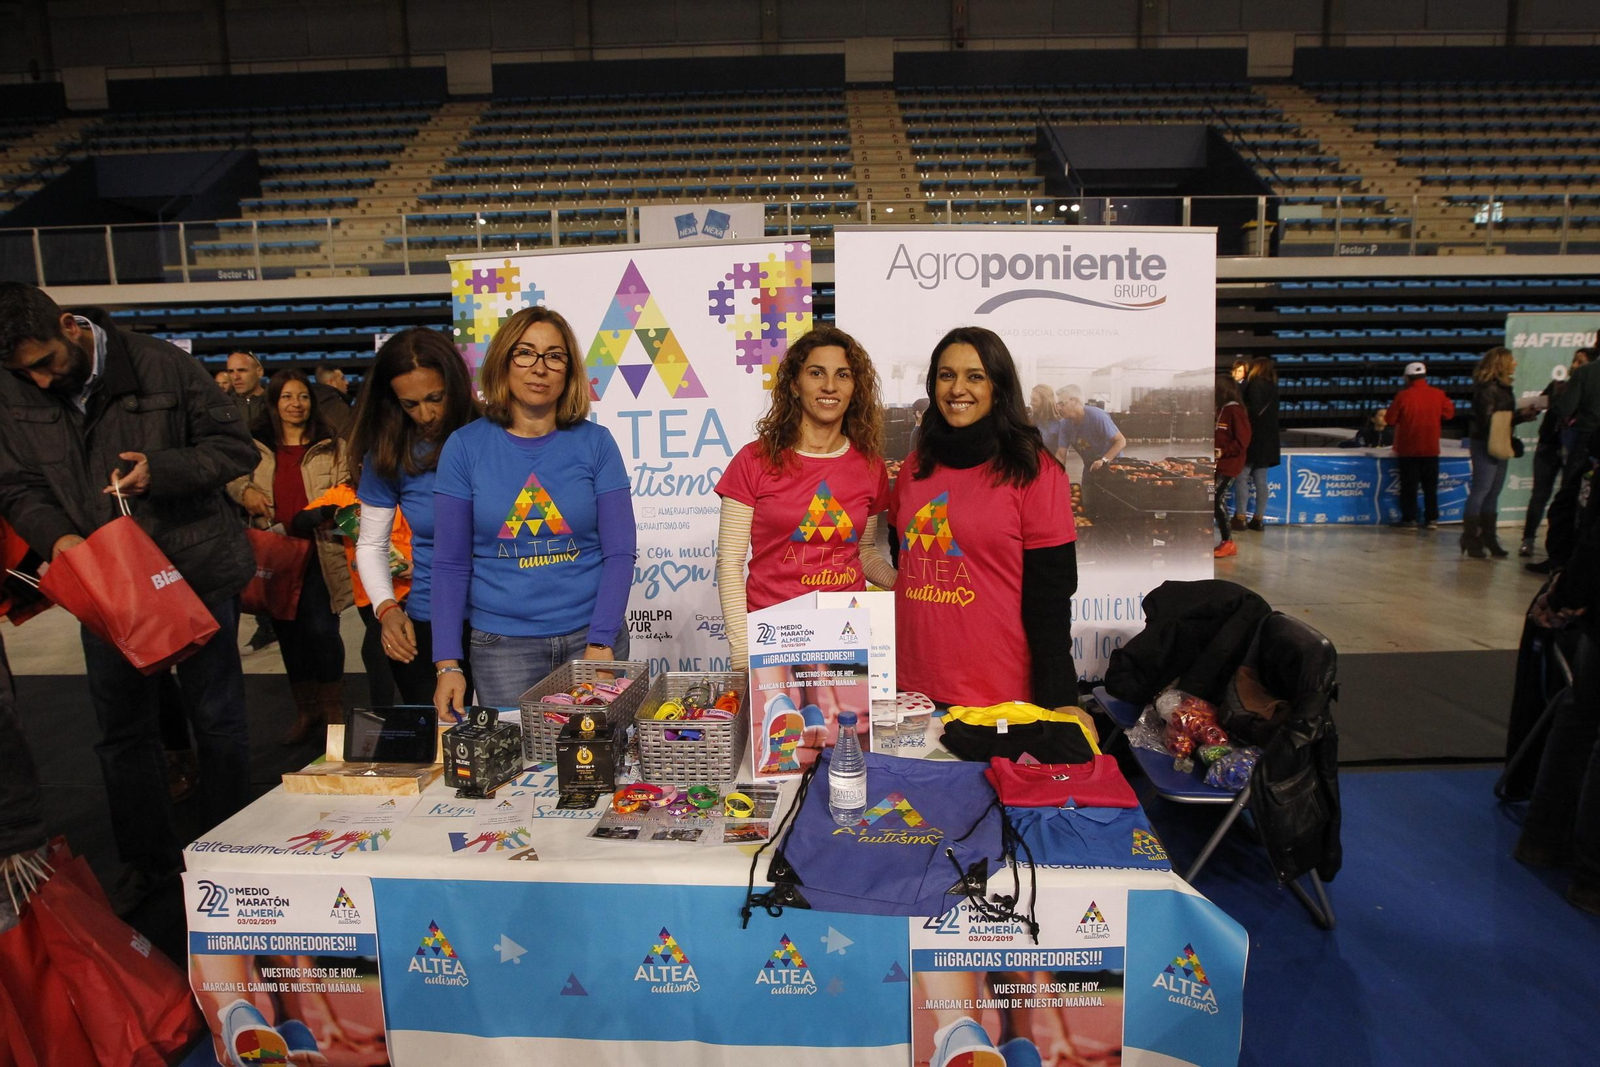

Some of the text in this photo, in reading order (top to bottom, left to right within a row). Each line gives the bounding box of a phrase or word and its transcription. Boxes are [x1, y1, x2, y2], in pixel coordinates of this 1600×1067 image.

[680, 226, 697, 237] NEXA
[704, 225, 723, 238] NEXA
[886, 243, 1167, 290] Agroponiente
[1114, 284, 1157, 298] GRUPO
[1021, 329, 1054, 337] SOCIAL
[1057, 329, 1119, 337] CORPORATIVA
[1326, 481, 1370, 489] MARATÓN
[647, 547, 674, 559] con
[629, 610, 672, 621] JUALPA
[781, 629, 814, 637] MARATÓN
[781, 635, 811, 643] ALMERÍA
[801, 650, 855, 662] CORREDORES!!!
[235, 887, 270, 896] MEDIO
[236, 896, 290, 907] MARATÓN
[237, 907, 285, 918] ALMERÍA
[330, 909, 361, 919] ALTEA
[968, 923, 1023, 934] ALMERÍA
[1075, 923, 1110, 934] ALTEA
[270, 936, 357, 951] CORREDORES!!!
[1005, 951, 1102, 967] CORREDORES!!!
[408, 956, 467, 977] ALTEA
[261, 967, 301, 978] VUESTROS
[302, 968, 328, 979] PASOS
[329, 968, 339, 978] DE
[633, 965, 699, 982] ALTEA
[755, 969, 816, 985] ALTEA
[237, 983, 247, 992] EL
[247, 983, 278, 993] CAMINO
[279, 983, 289, 993] DE
[291, 983, 326, 993] NUESTRO
[328, 981, 364, 993] MAÑANA.
[994, 983, 1037, 994] VUESTROS
[1039, 983, 1067, 993] PASOS
[1068, 983, 1080, 993] DE
[1152, 973, 1217, 1006] ALTEA
[964, 999, 974, 1009] EL
[976, 998, 1010, 1009] CAMINO
[1011, 998, 1022, 1009] DE
[1024, 997, 1063, 1008] NUESTRO
[1065, 996, 1105, 1008] MAÑANA.
